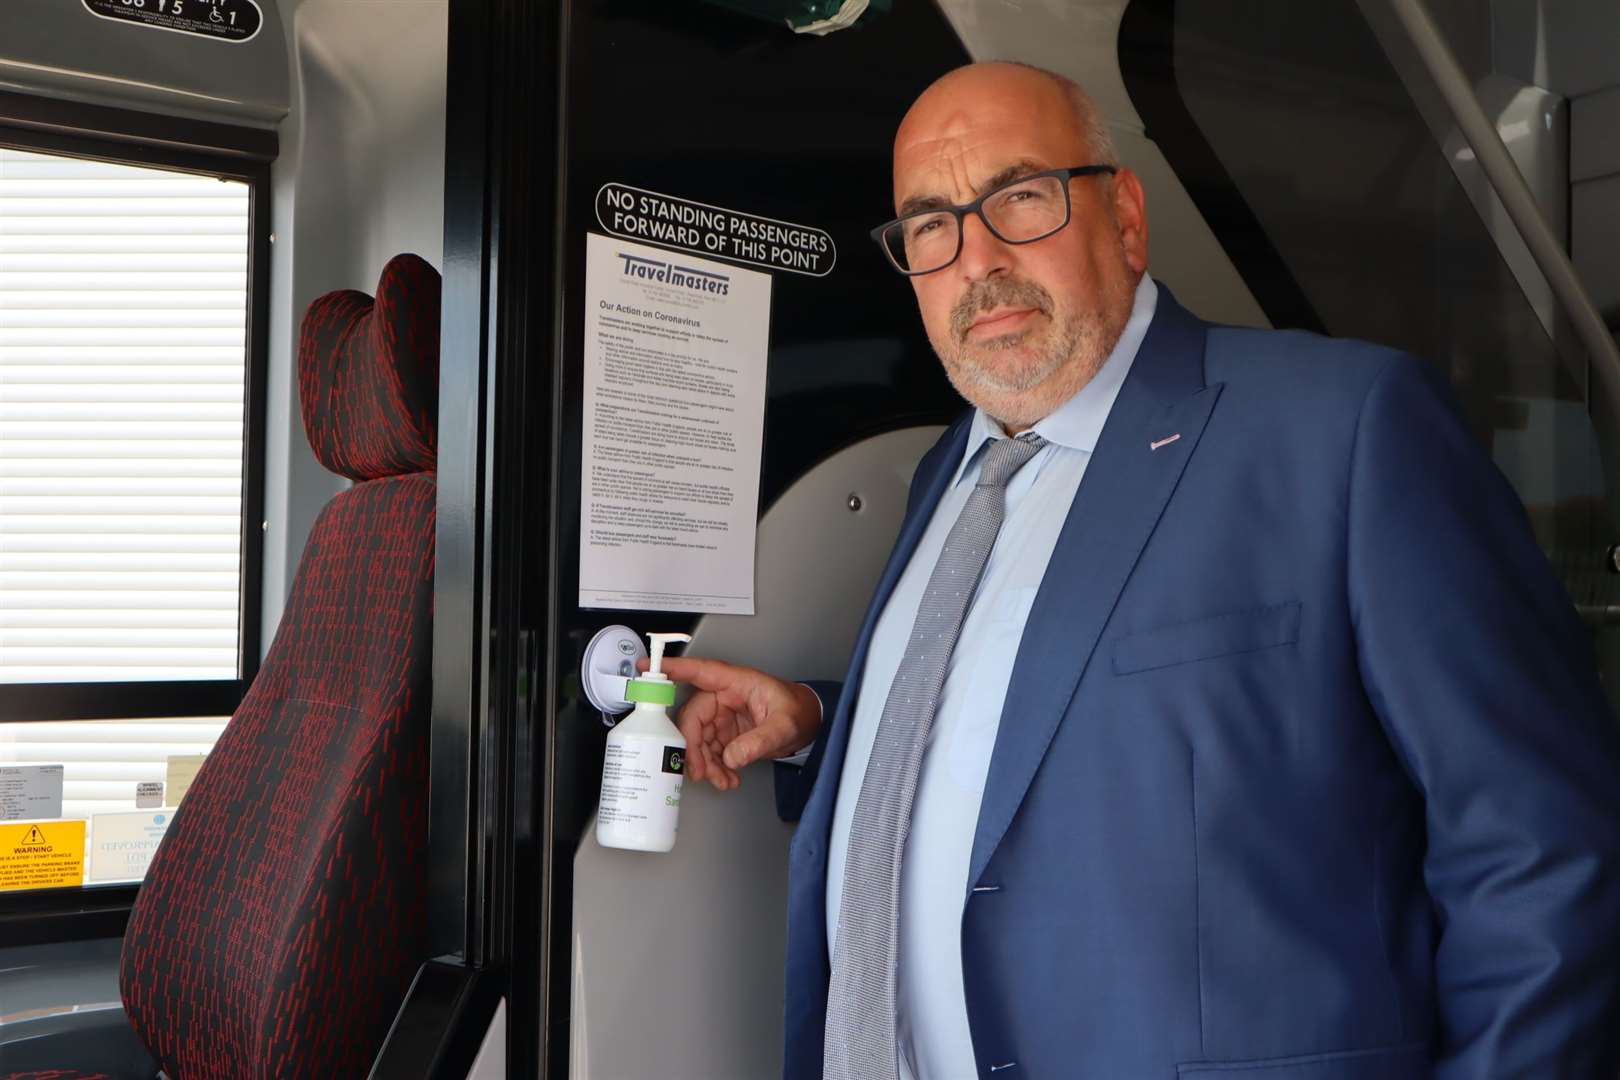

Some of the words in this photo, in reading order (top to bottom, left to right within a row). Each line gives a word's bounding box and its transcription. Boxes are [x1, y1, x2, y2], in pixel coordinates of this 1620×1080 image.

[171, 0, 183, 15] 5
[229, 11, 237, 25] 1
[607, 188, 635, 210] NO
[640, 196, 725, 231] STANDING
[730, 217, 827, 252] PASSENGERS
[614, 212, 700, 246] FORWARD
[704, 232, 727, 251] OF
[732, 238, 766, 260] THIS
[771, 246, 819, 270] POINT
[618, 253, 730, 295] Travelmasters
[600, 300, 614, 310] Our
[616, 304, 641, 316] Action
[654, 311, 700, 328] Coronavirus
[14, 846, 53, 854] WARNING
